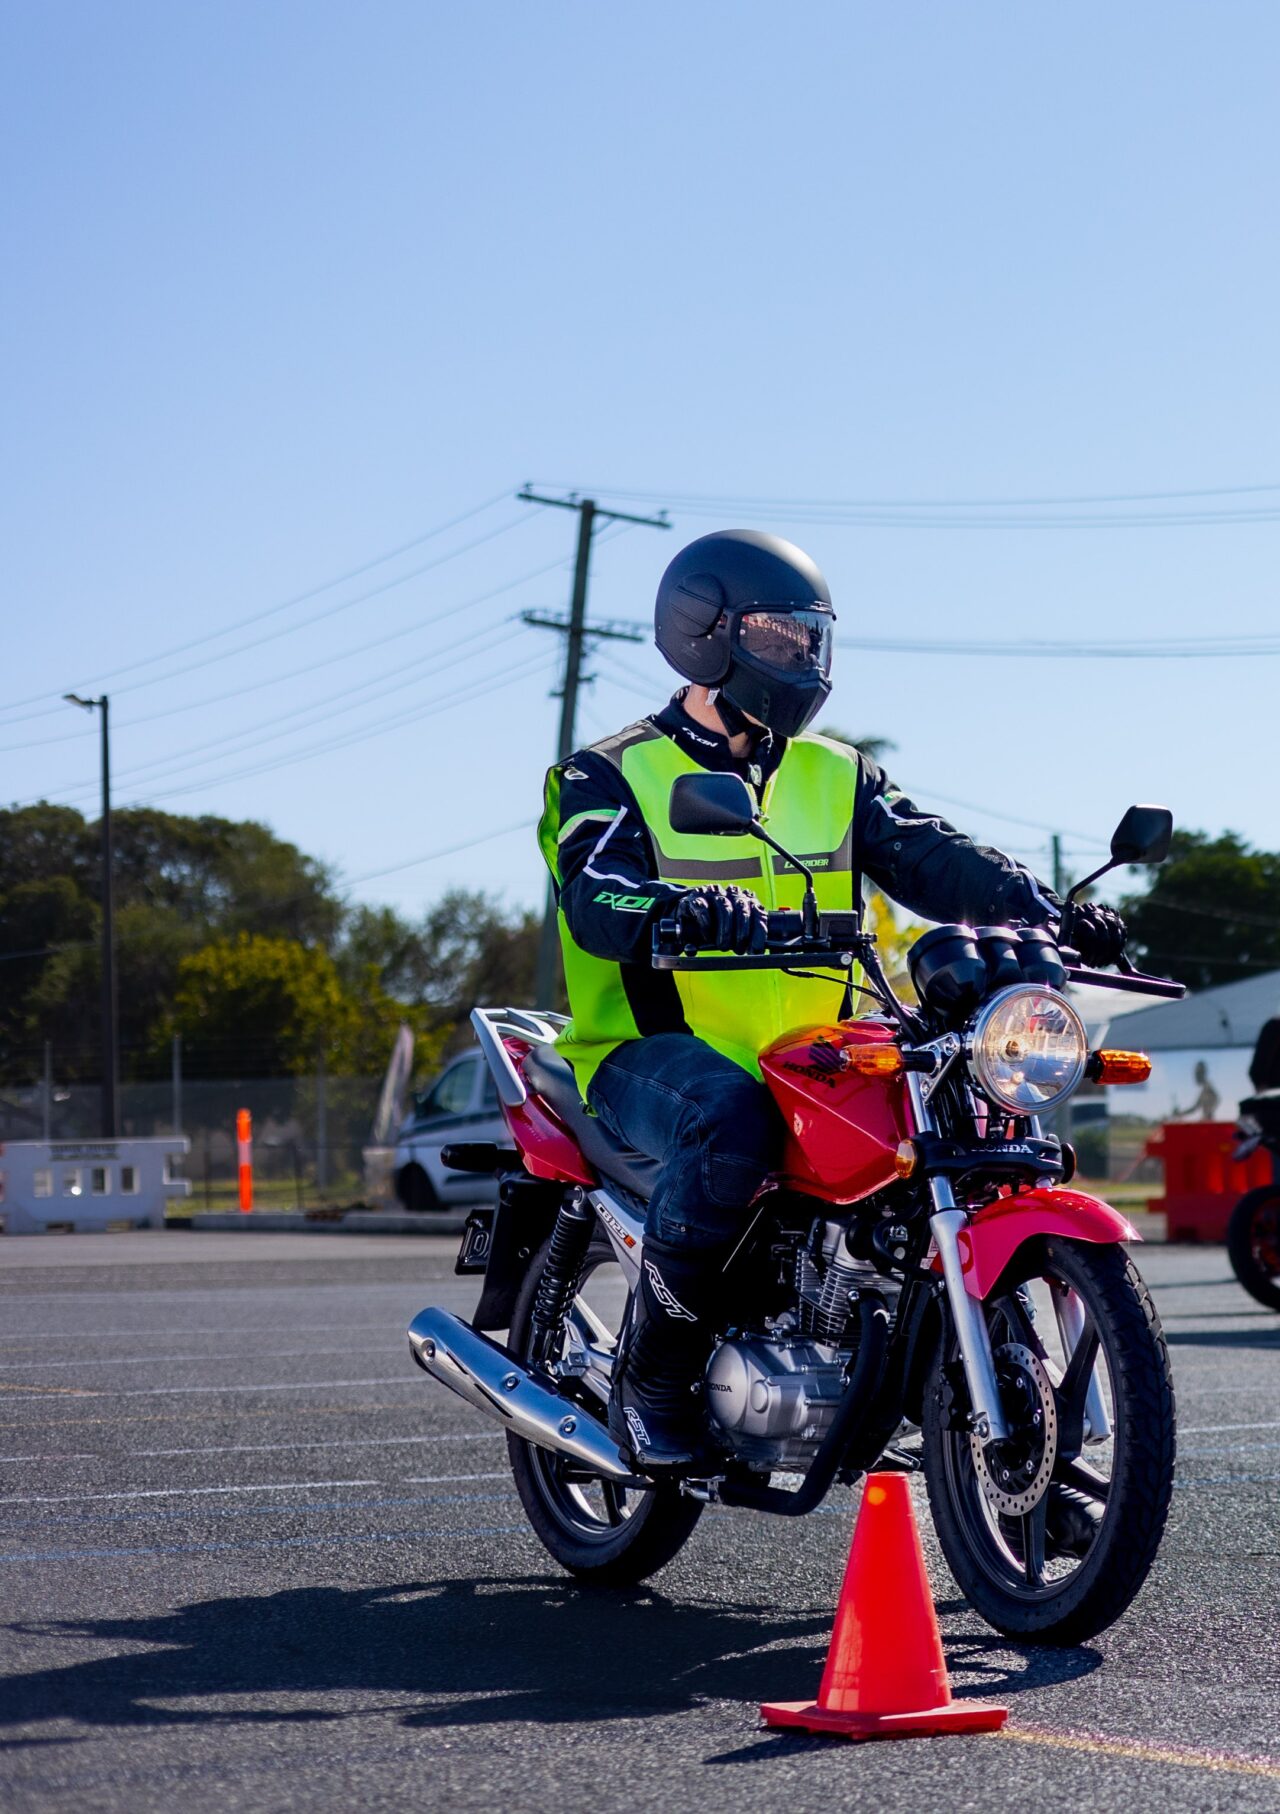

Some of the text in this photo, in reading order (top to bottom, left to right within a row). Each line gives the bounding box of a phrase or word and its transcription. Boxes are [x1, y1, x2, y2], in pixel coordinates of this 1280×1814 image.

[783, 1061, 836, 1088] HONDA
[644, 1259, 698, 1321] RST
[623, 1406, 651, 1445] RST
